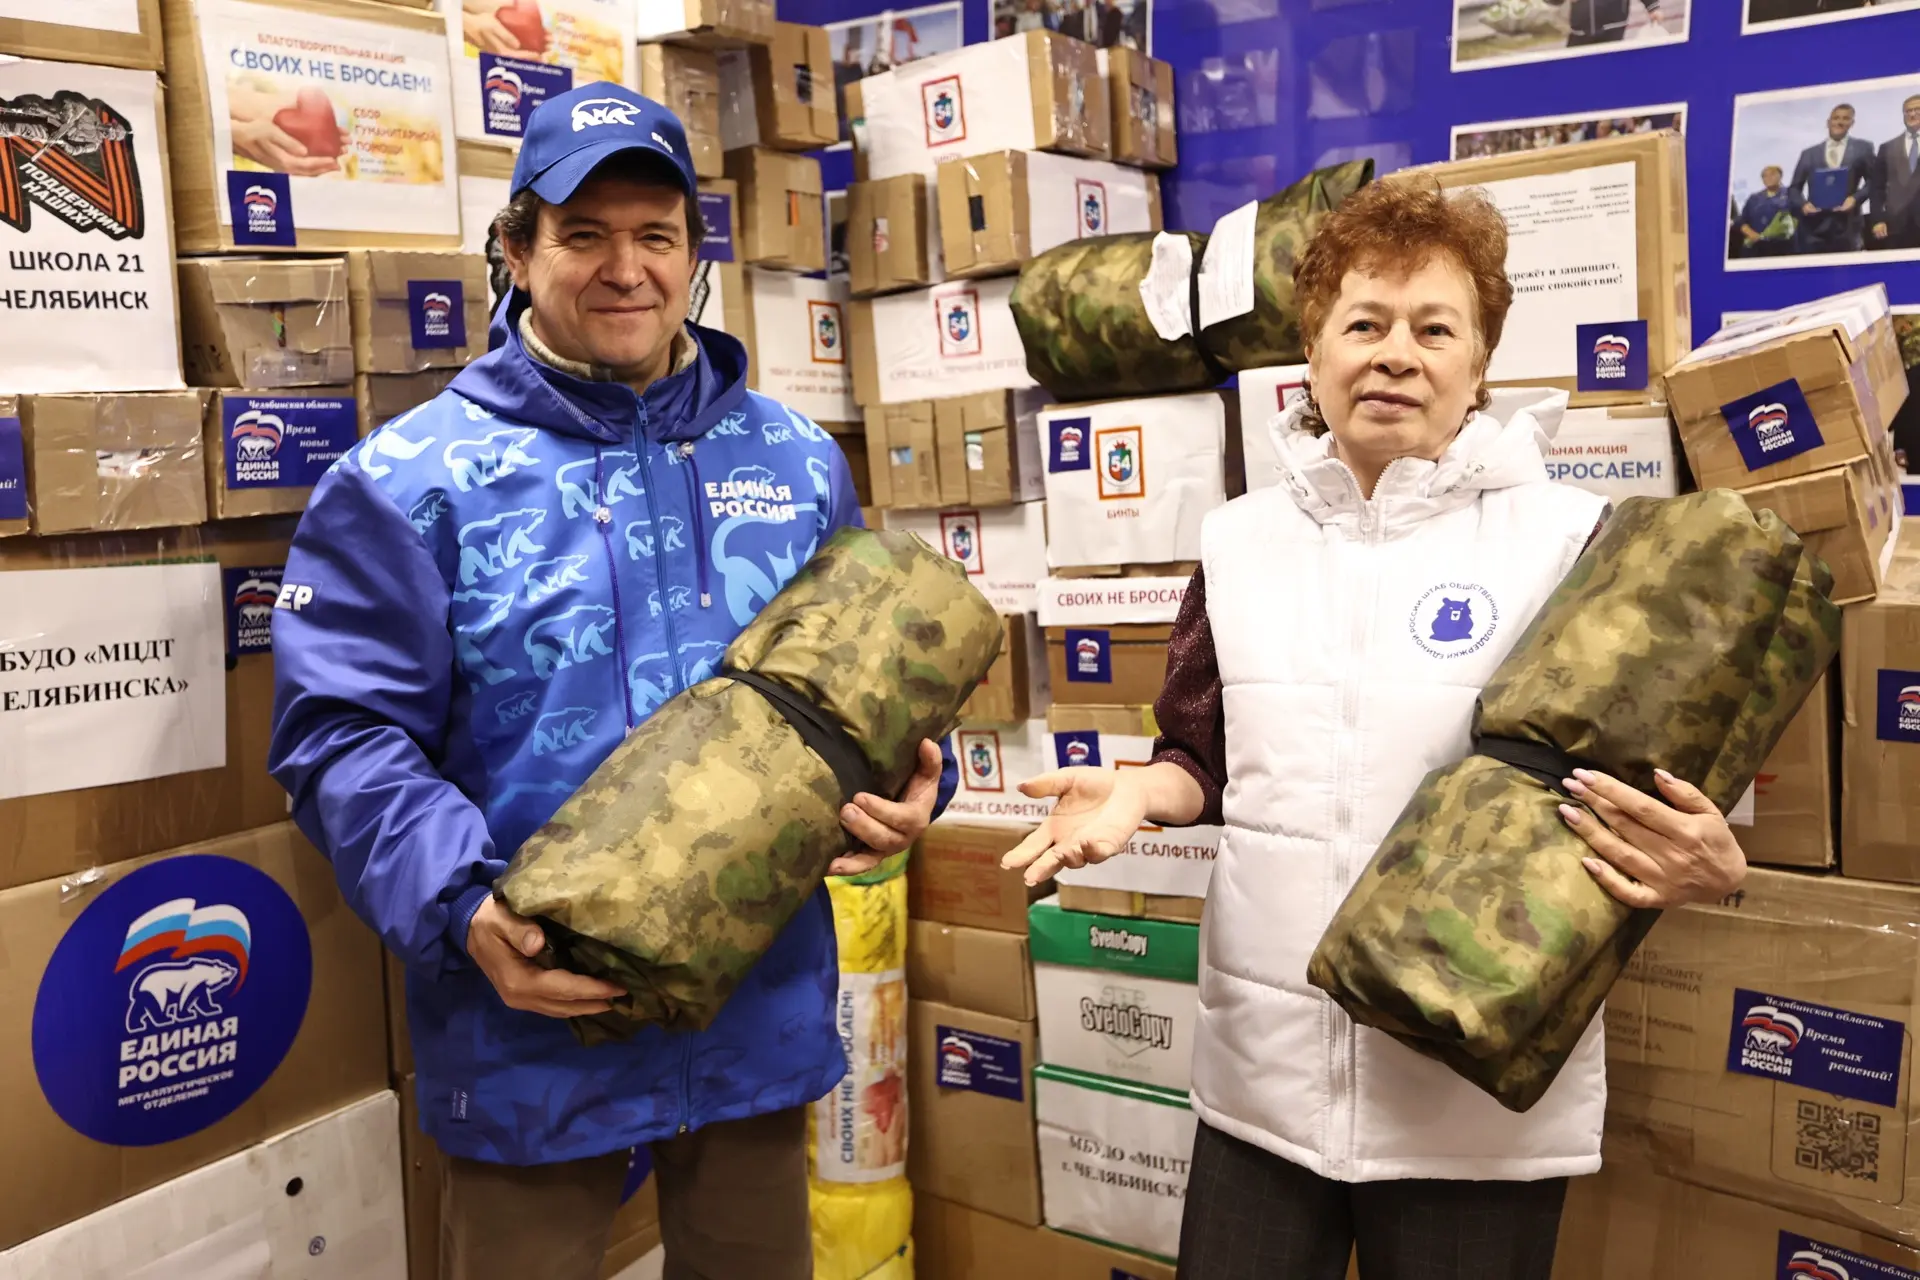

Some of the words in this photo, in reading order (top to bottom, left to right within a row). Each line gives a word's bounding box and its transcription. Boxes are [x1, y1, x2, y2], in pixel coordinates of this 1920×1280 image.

[257, 33, 371, 58] БЛАГОТВОРИТЕЛЬНАЯ
[230, 48, 303, 76] СВОИХ
[308, 60, 335, 81] НЕ
[340, 64, 433, 93] БРОСАЕМ!
[19, 161, 126, 235] ПОДДЕРЖИМ
[21, 181, 94, 227] НАШИХ!
[9, 250, 111, 272] ШКОЛА
[117, 253, 144, 273] 21
[1509, 269, 1545, 282] ережёт
[1517, 283, 1545, 294] наше
[285, 424, 317, 438] Время
[299, 440, 330, 448] новых
[1587, 444, 1628, 456] АКЦИЯ
[236, 461, 279, 472] ЕДИНАЯ
[1111, 455, 1131, 472] 54
[1546, 461, 1662, 480] БРОСАЕМ!
[237, 470, 279, 481] РОССИЯ
[704, 480, 792, 502] ЕДИНАЯ
[709, 498, 797, 521] РОССИЯ
[1107, 508, 1140, 519] БИНТЫ
[1057, 592, 1103, 607] СВОИХ
[1107, 591, 1125, 605] НЕ
[1130, 588, 1186, 605] БРОСАЕ
[1421, 583, 1447, 600] ШТАБ
[1449, 582, 1500, 621] ОБЩЕСТВЕННОЙ
[83, 637, 175, 665] «МЦДТ
[238, 636, 271, 647] РОССИ
[1412, 634, 1444, 660] ЕДИНОЙ
[1446, 623, 1497, 660] ПОДДЕРЖКИ
[2, 676, 190, 712] ЕЛЯБИНСКА»
[1089, 925, 1148, 957] SvetoCopy
[1080, 996, 1173, 1051] SvetoCopy
[1765, 996, 1834, 1019] Челябинская
[1835, 1012, 1885, 1029] область
[119, 1015, 239, 1063] ЕДИНАЯ
[1805, 1027, 1846, 1046] Время
[118, 1040, 238, 1090] РОССИЯ
[1742, 1048, 1793, 1067] ЕДИНАЯ
[1820, 1046, 1864, 1063] новых
[1741, 1057, 1792, 1077] РОССИЯ
[1828, 1061, 1894, 1083] решений!
[118, 1069, 235, 1108] МЕТАЛЛУРГИЧЕСКОЕ
[143, 1086, 209, 1112] ОТДЕЛЕНИЕ
[841, 1107, 854, 1164] СВОИХ
[1809, 1242, 1879, 1270] Челябинская
